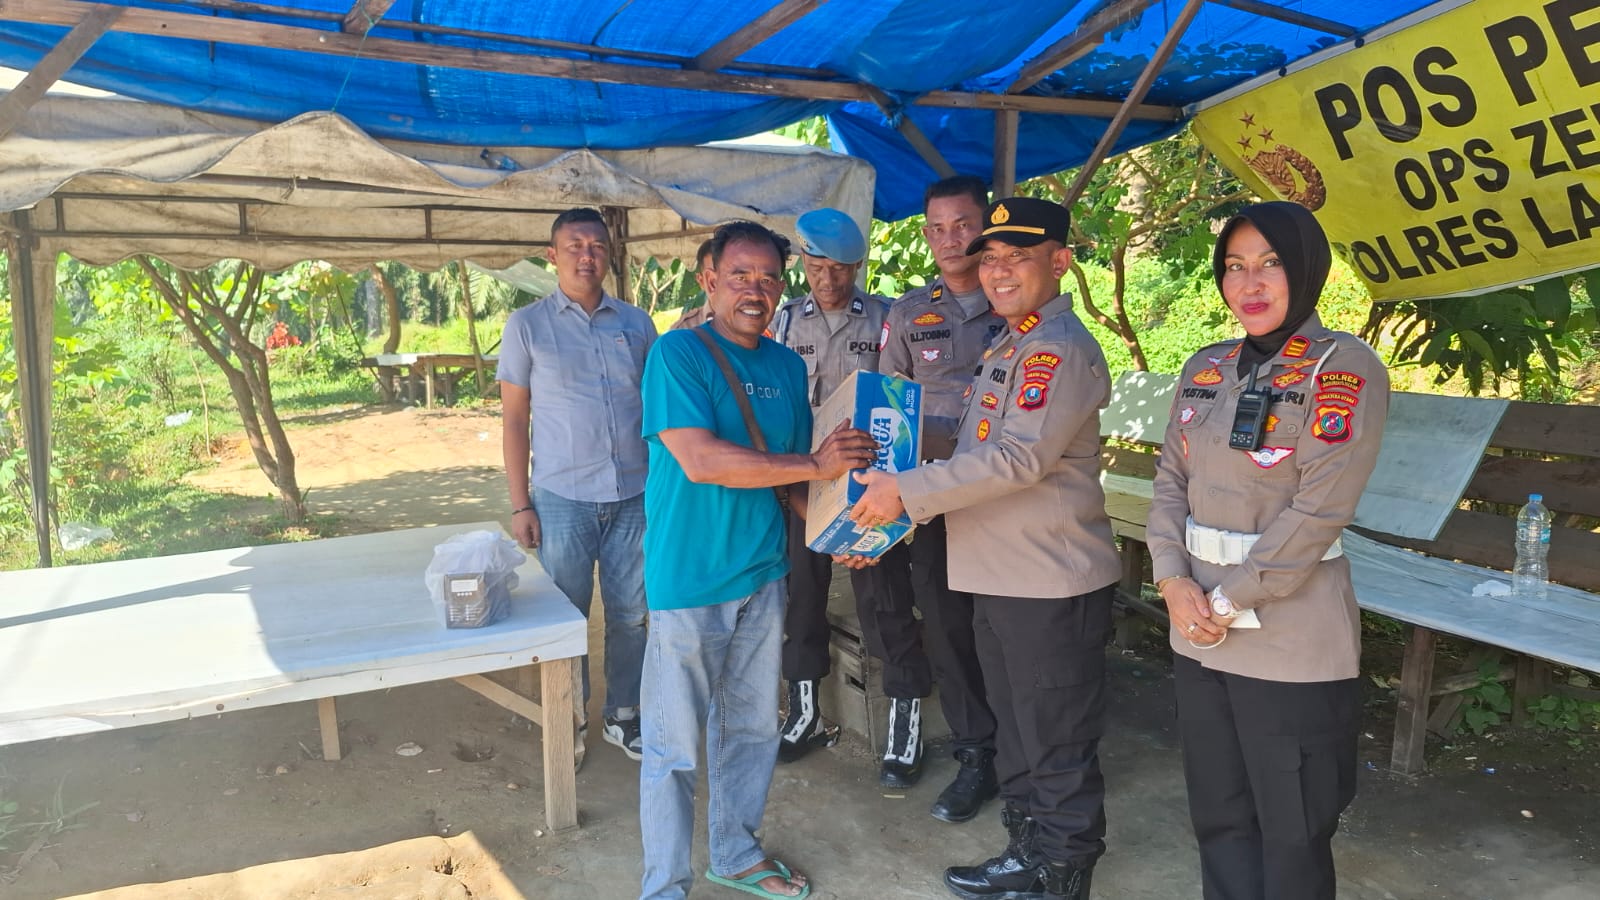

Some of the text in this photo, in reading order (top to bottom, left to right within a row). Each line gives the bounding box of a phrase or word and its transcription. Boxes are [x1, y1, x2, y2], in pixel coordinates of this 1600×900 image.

[1314, 46, 1478, 161] POS
[1394, 103, 1600, 211] OPS ZE
[1334, 208, 1518, 284] OLRES
[1322, 373, 1359, 384] POLRES
